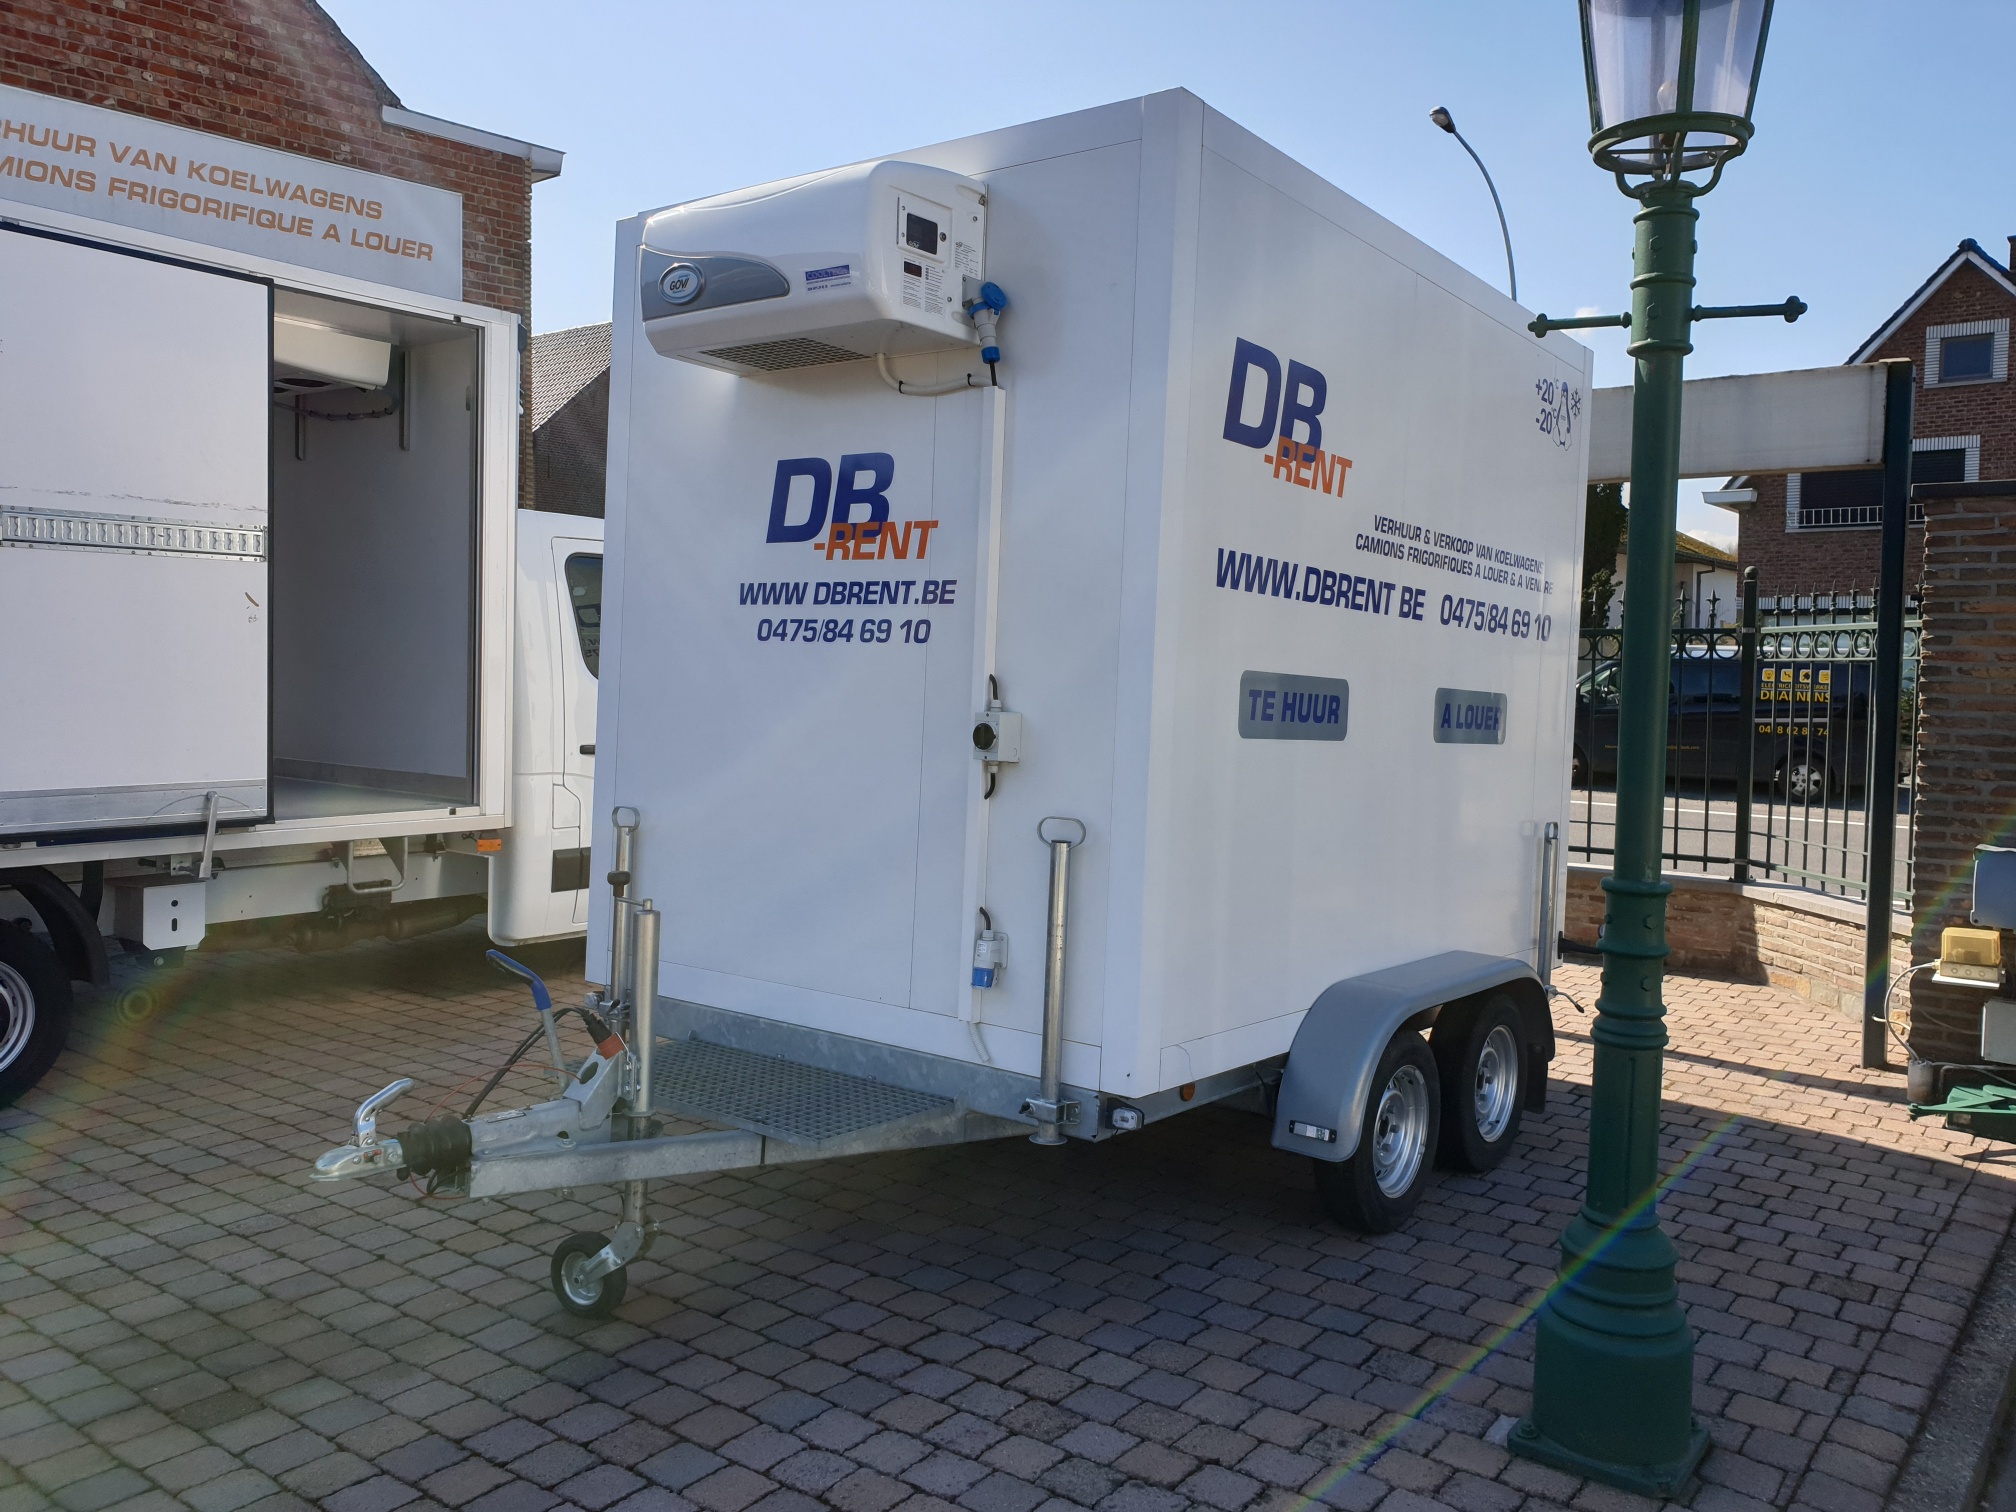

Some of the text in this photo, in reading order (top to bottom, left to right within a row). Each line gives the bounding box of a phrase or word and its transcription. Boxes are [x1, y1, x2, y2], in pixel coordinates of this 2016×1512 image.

[0, 118, 383, 220] HUUR VAN KOELWAGENS
[107, 176, 314, 237] FRIGORIFIQUE
[322, 223, 341, 243] A
[350, 228, 434, 261] LOUER
[1222, 336, 1328, 466] DB
[766, 452, 895, 543] DB
[1355, 533, 1554, 595] CAMIONS FRIGORIFIQUES A LOUER & A VENRE
[1374, 514, 1545, 575] VERHUUR & VERKOOP VAN KOELWAGENS
[739, 579, 957, 605] WWW DBRENT.BE
[1439, 593, 1509, 635] 0475/84
[1511, 608, 1531, 639] 69
[1534, 613, 1552, 642] 10
[757, 618, 931, 644] 0475/84 69 10
[1249, 689, 1341, 724] TE HUUR
[1440, 703, 1503, 731] A LOUER
[1759, 725, 1783, 734] 048
